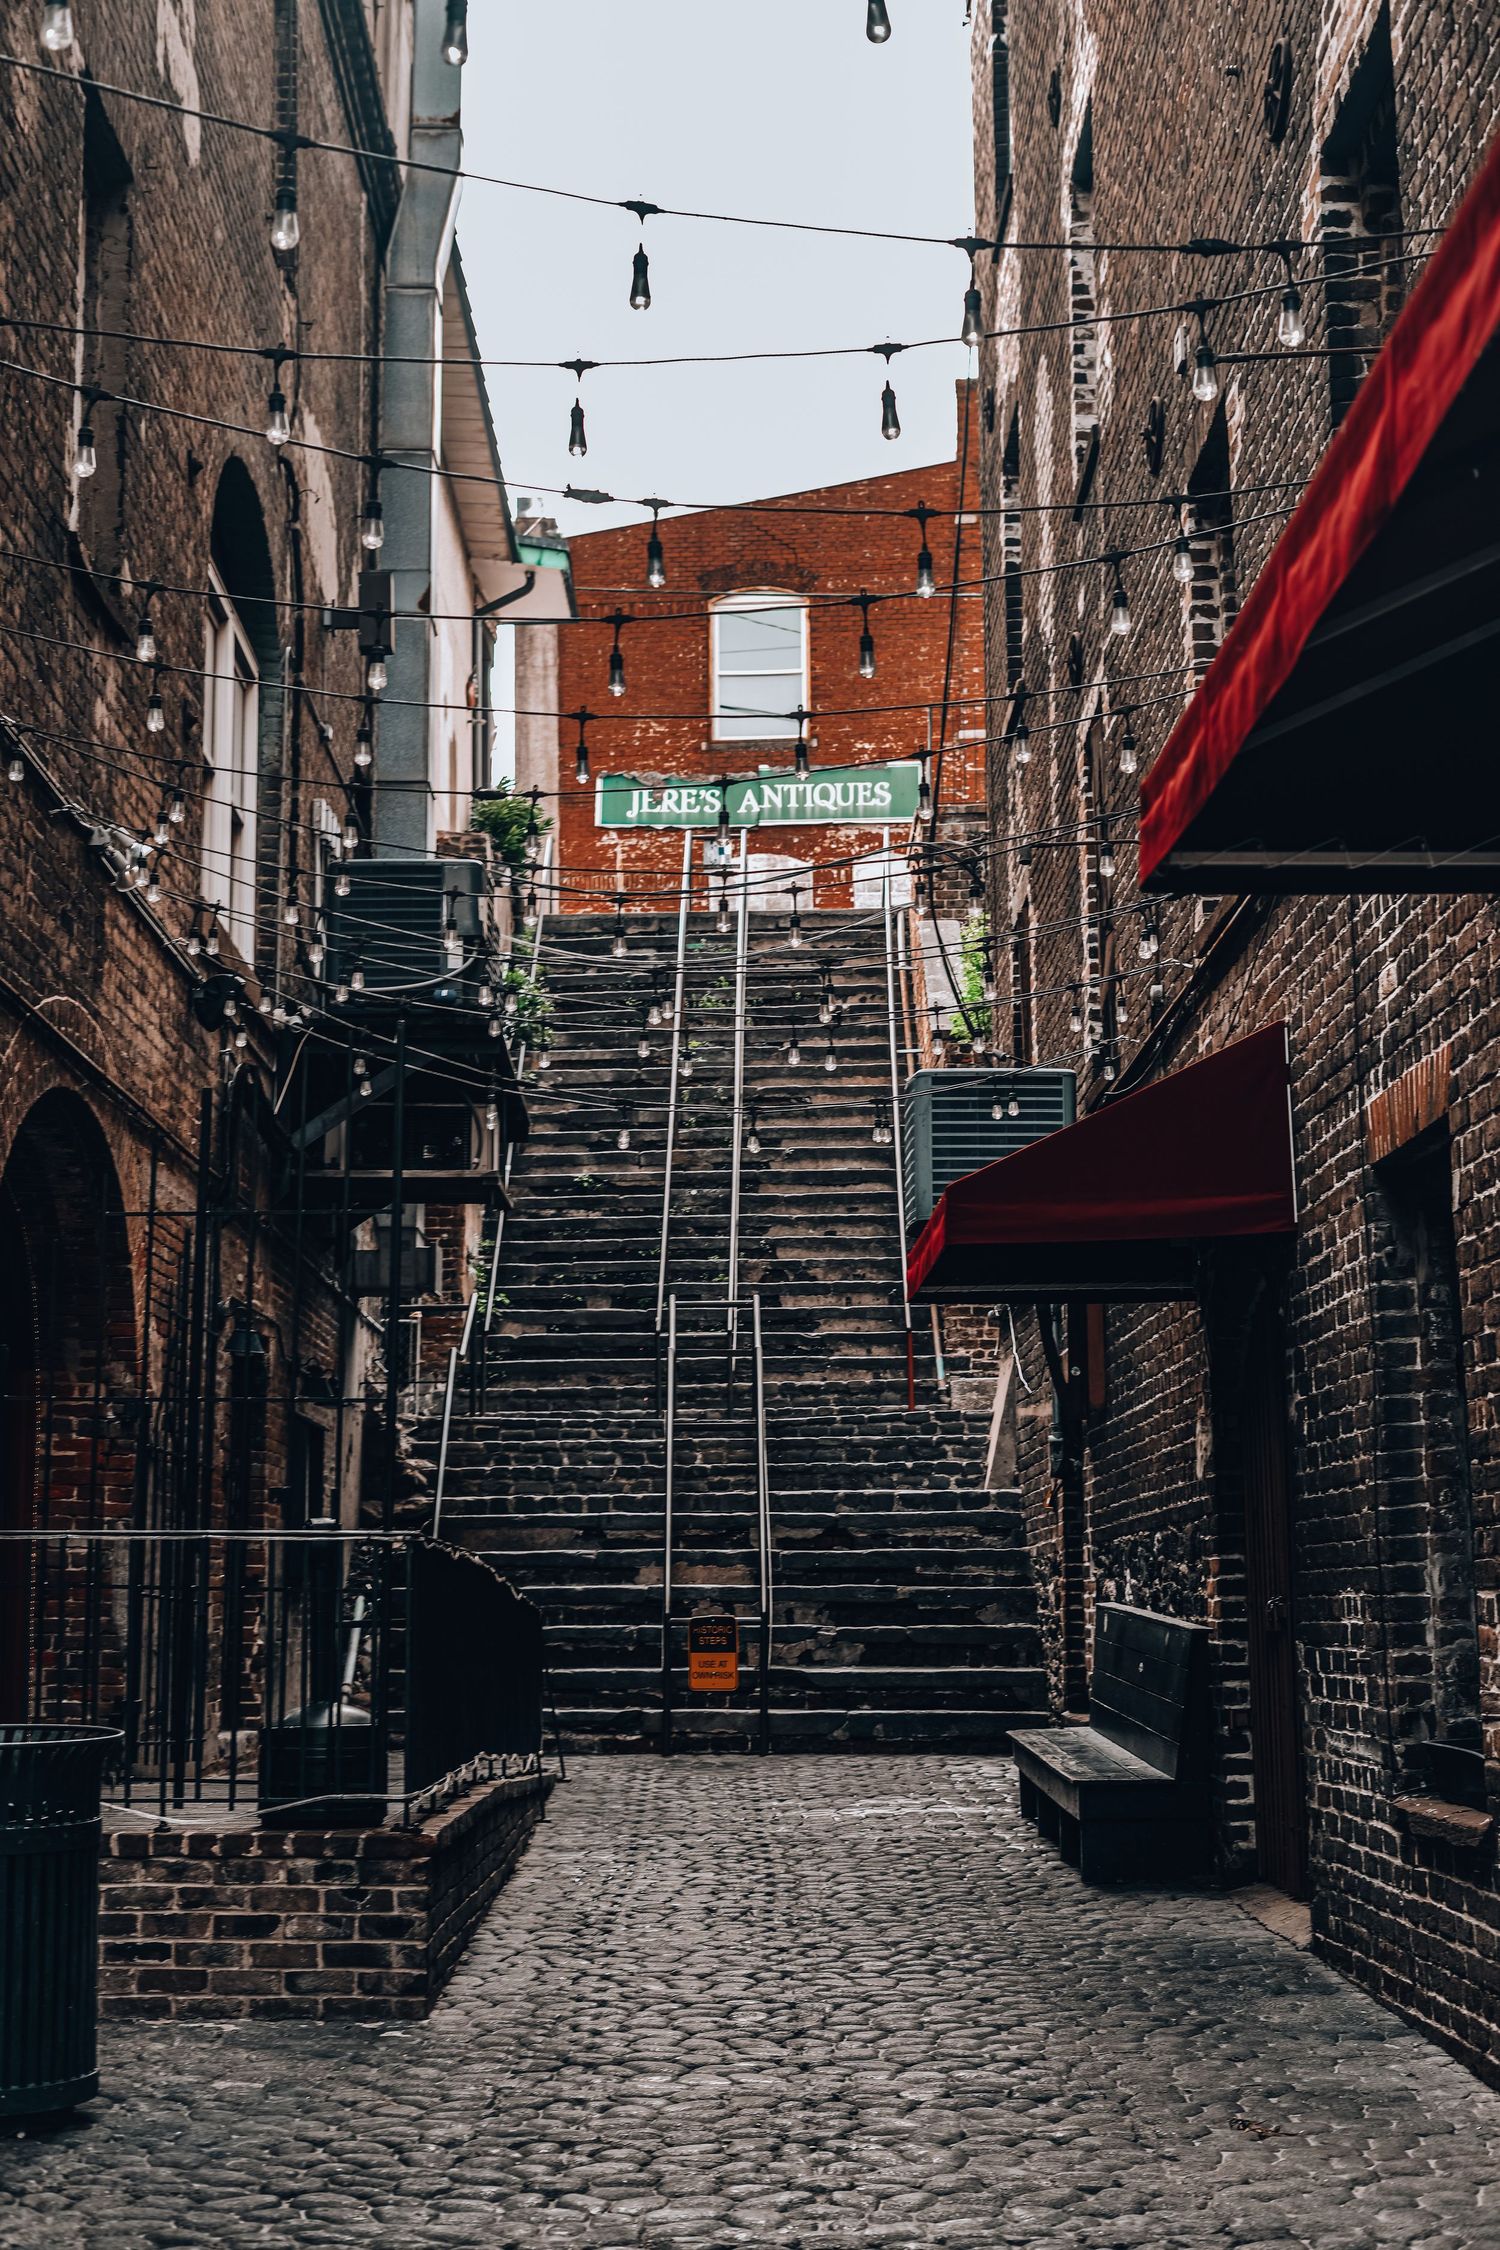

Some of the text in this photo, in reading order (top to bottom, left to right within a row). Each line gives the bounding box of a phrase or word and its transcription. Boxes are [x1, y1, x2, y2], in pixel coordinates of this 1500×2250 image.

[626, 781, 892, 818] JERE'S ANTIQUES
[692, 1625, 733, 1634] HISTORIC
[698, 1636, 728, 1645] STEPS
[698, 1660, 729, 1669] USE AT
[692, 1671, 735, 1680] OWN RISK
